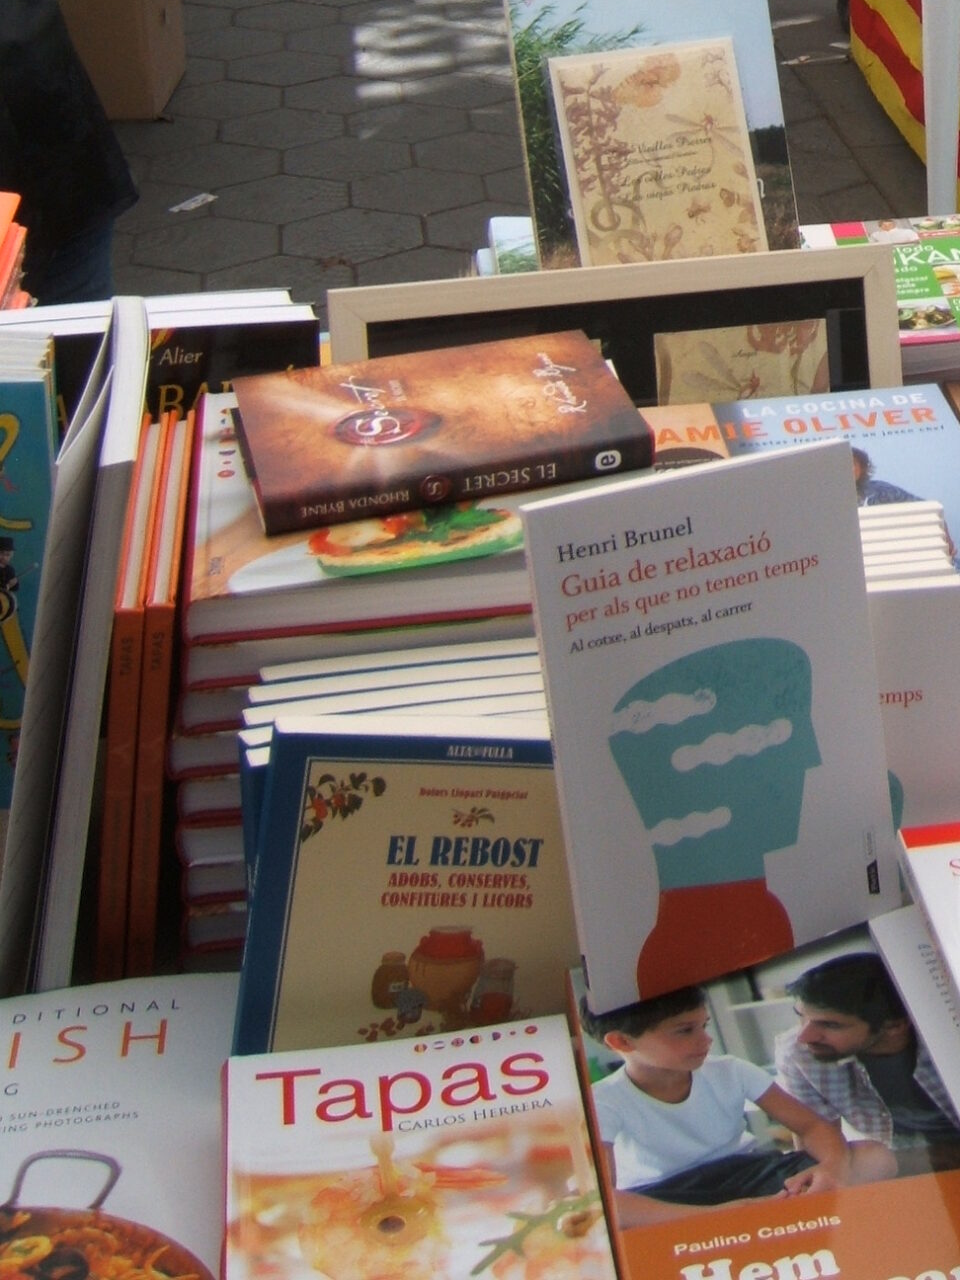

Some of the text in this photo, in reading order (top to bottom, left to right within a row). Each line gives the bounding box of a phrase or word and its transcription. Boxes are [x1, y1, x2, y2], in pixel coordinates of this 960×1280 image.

[159, 347, 203, 365] Alier
[742, 393, 927, 419] LA COCINA DE
[784, 407, 938, 435] OLIVER
[462, 463, 557, 493] EL SECRET
[300, 490, 410, 517] RHONDA BYRNE
[558, 516, 693, 562] Henri Brunel
[561, 530, 771, 598] Guia de relaxació
[566, 552, 820, 632] per als que no tenen temps
[570, 601, 753, 654] Al cotxe, al despatx, al carrer
[386, 835, 544, 868] EL REBOST
[388, 872, 530, 889] ADOBS, CONSERVES,
[381, 892, 534, 909] CONFITURES LICORS
[8, 1018, 168, 1069] ISH
[255, 1050, 550, 1132] Tapas
[35, 1111, 139, 1129] PHOTOGRAPHS
[398, 1096, 553, 1134] CARLOS HERRERA
[673, 1214, 841, 1257] Paulino Castells
